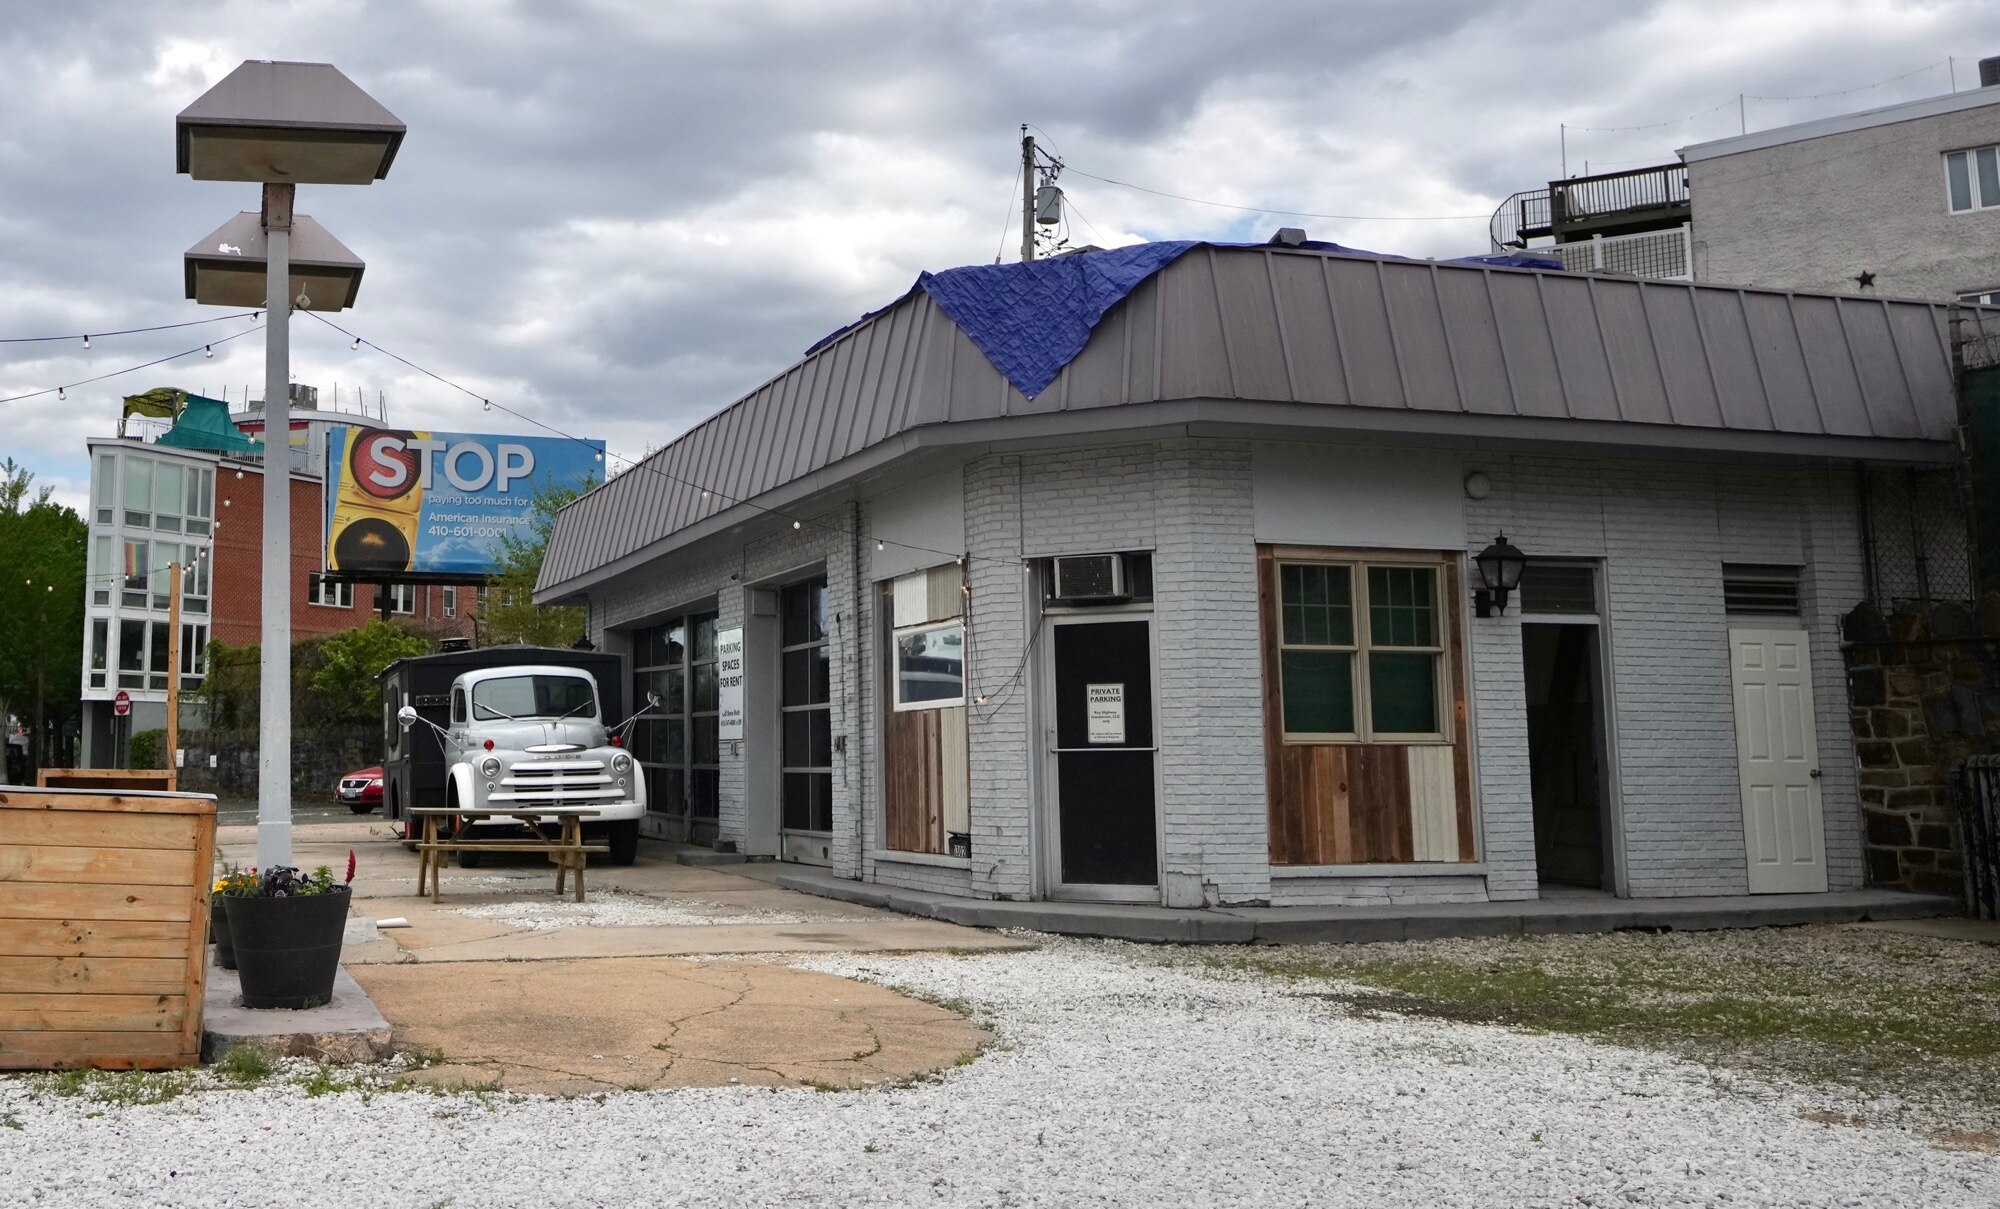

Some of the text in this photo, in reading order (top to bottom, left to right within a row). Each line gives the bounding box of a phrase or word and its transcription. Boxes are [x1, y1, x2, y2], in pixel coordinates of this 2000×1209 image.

[369, 437, 535, 492] STOP
[428, 496, 462, 506] paying
[464, 496, 482, 505] too
[484, 497, 512, 506] much
[514, 497, 528, 507] for
[428, 512, 531, 525] American Insurance
[428, 526, 507, 538] 410-601-0001
[720, 642, 740, 654] PARKING
[722, 659, 740, 671] SPACES
[720, 675, 743, 688] FOR RENT
